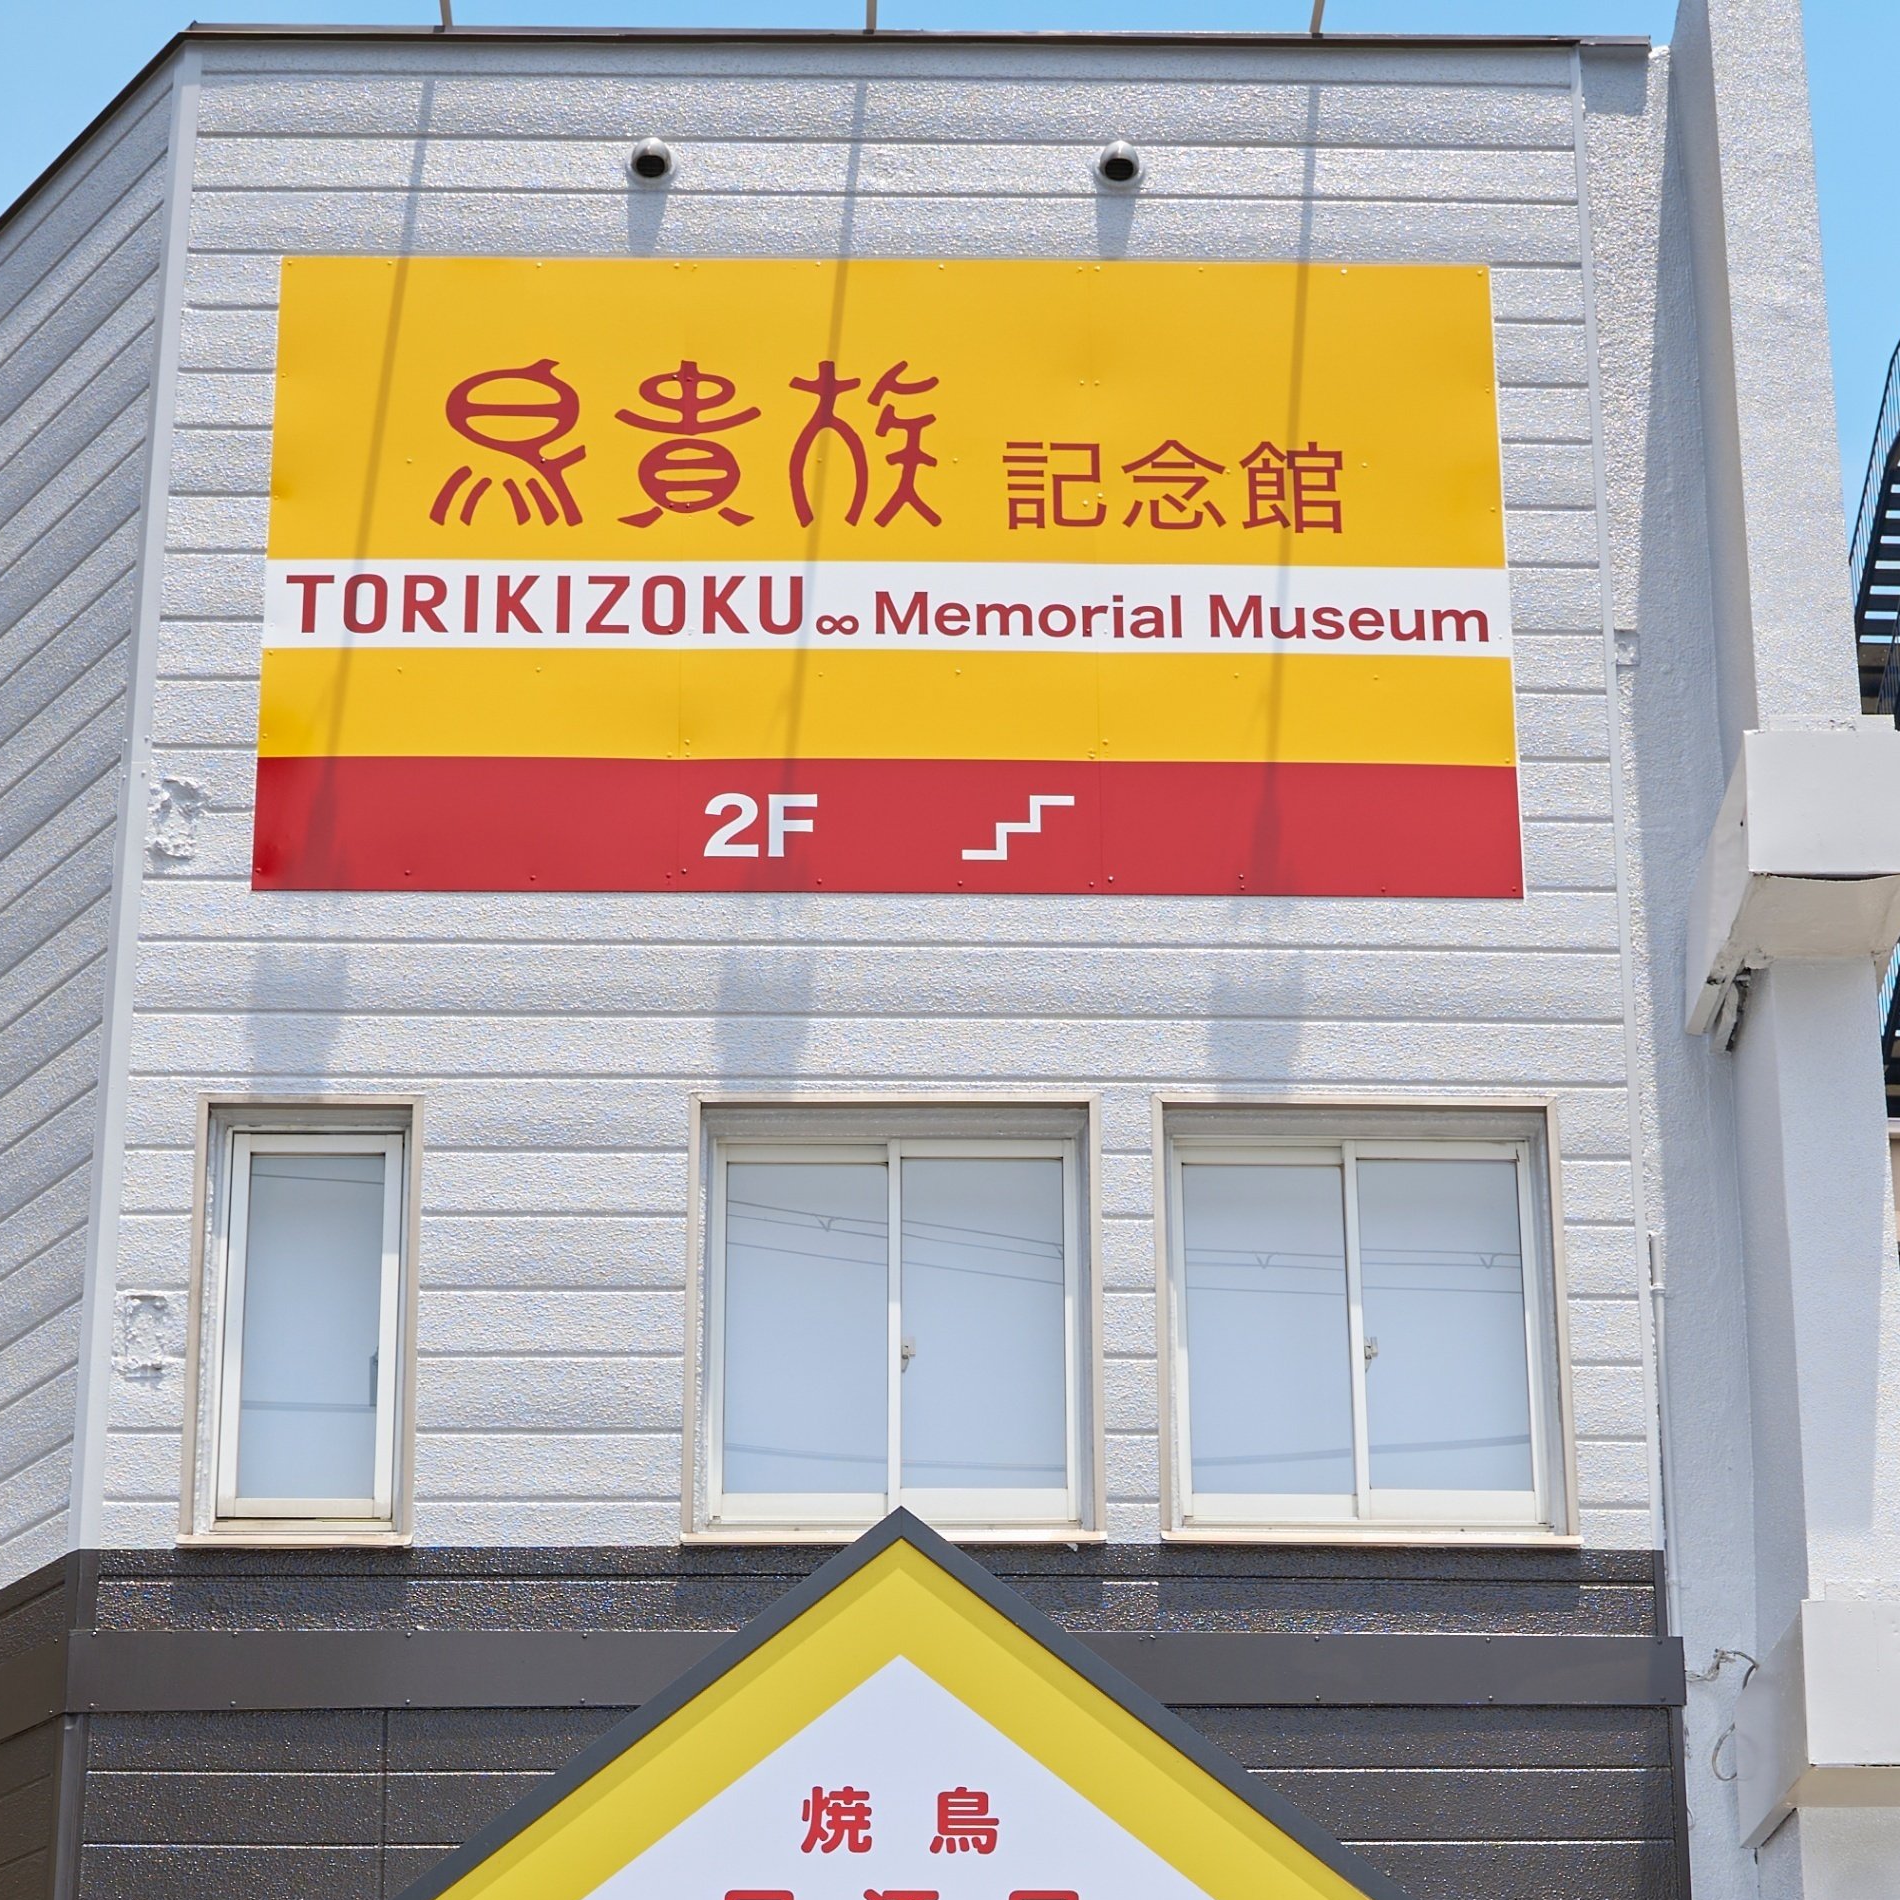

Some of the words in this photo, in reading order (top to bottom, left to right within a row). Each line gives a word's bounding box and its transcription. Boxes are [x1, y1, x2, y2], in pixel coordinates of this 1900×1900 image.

[428, 358, 942, 529] 鳥貴族
[1002, 439, 1344, 534] 記念館
[875, 590, 1183, 640] Memorial
[1209, 594, 1490, 643] Museum
[702, 792, 819, 858] 2F
[800, 1785, 1000, 1855] 焼鳥
